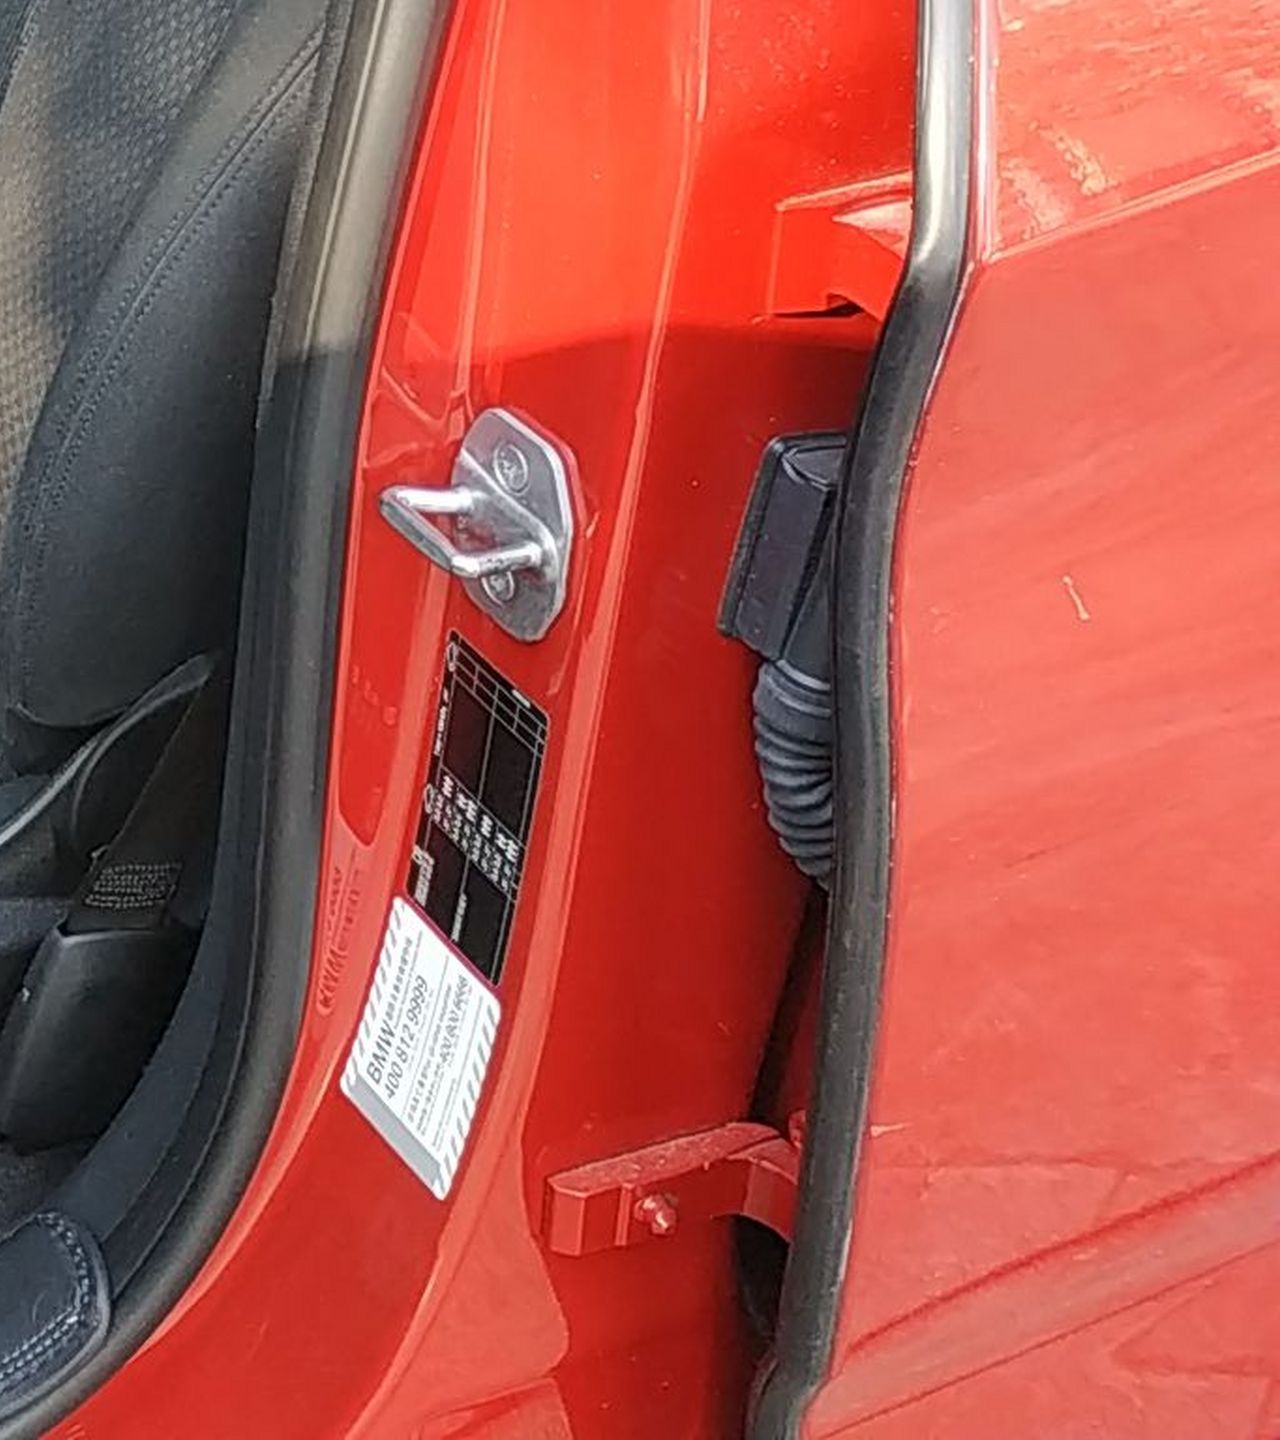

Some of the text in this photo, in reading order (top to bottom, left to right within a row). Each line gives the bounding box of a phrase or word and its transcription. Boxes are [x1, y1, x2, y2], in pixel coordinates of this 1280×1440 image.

[366, 1019, 395, 1084] BMW
[395, 1024, 415, 1063] 812
[406, 974, 427, 1026] 9999
